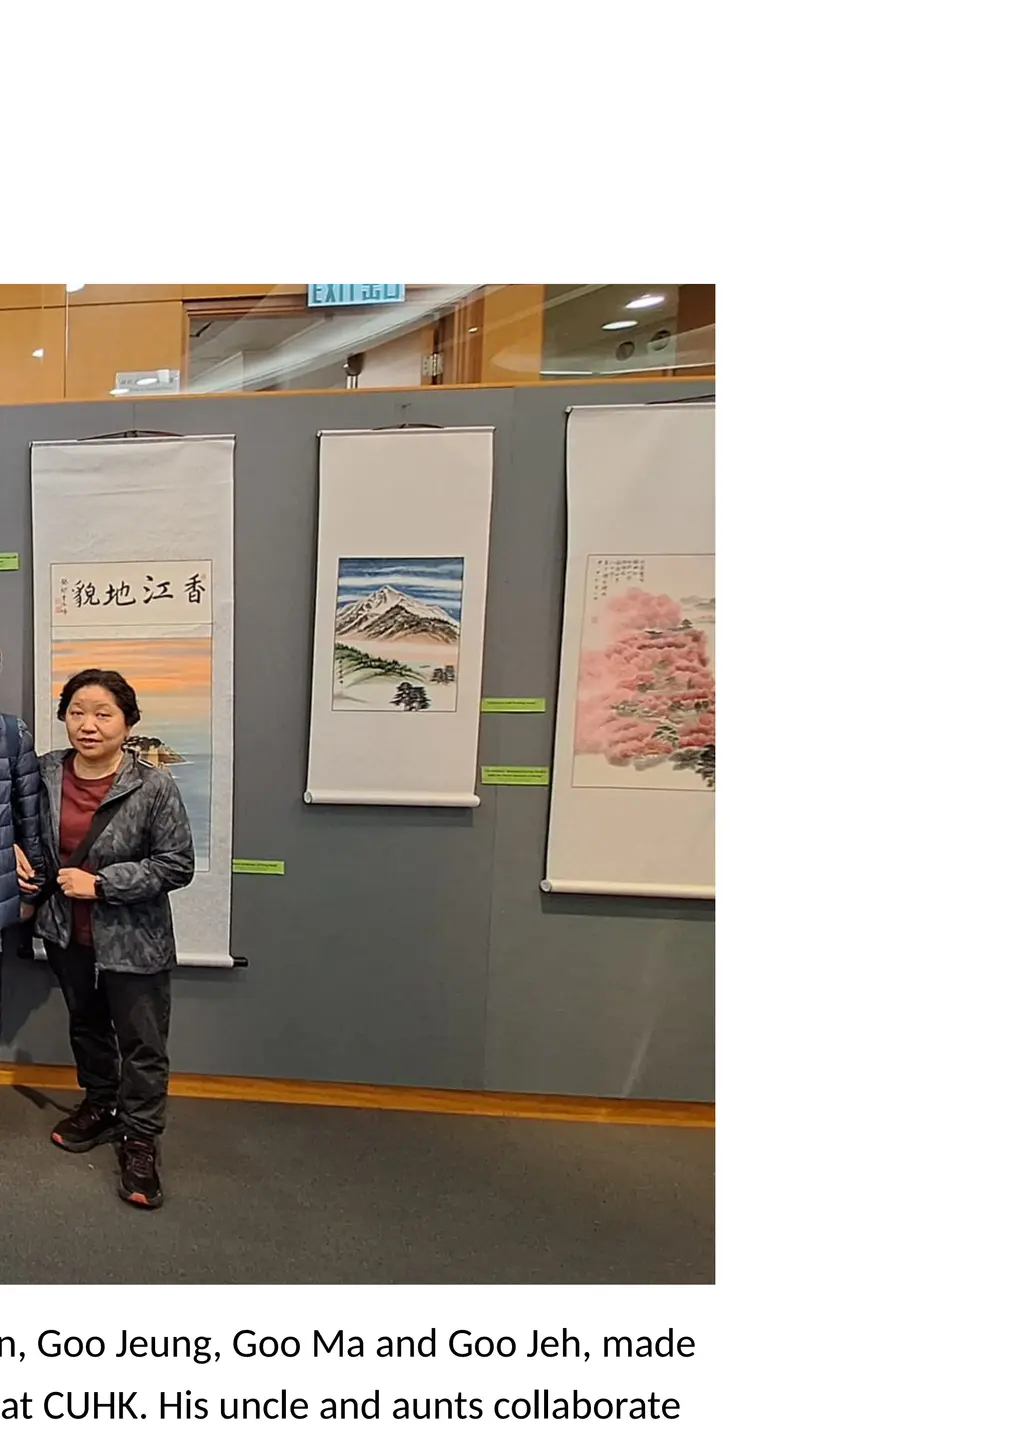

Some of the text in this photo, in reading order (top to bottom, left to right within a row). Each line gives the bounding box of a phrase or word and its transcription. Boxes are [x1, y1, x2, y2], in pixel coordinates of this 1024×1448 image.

[38, 1330, 105, 1357] Goo
[116, 1330, 220, 1364] Jeung,
[233, 1330, 300, 1357] Goo
[314, 1330, 363, 1357] Ma
[377, 1328, 435, 1357] and
[449, 1330, 516, 1357] Goo
[527, 1328, 589, 1362] Jeh,
[604, 1328, 695, 1357] made
[2, 1392, 32, 1419] at
[44, 1392, 146, 1419] CUHK.
[161, 1390, 208, 1419] His
[221, 1389, 308, 1419] uncle
[320, 1390, 379, 1419] and
[393, 1392, 482, 1419] aunts
[494, 1390, 680, 1419] collaborate
